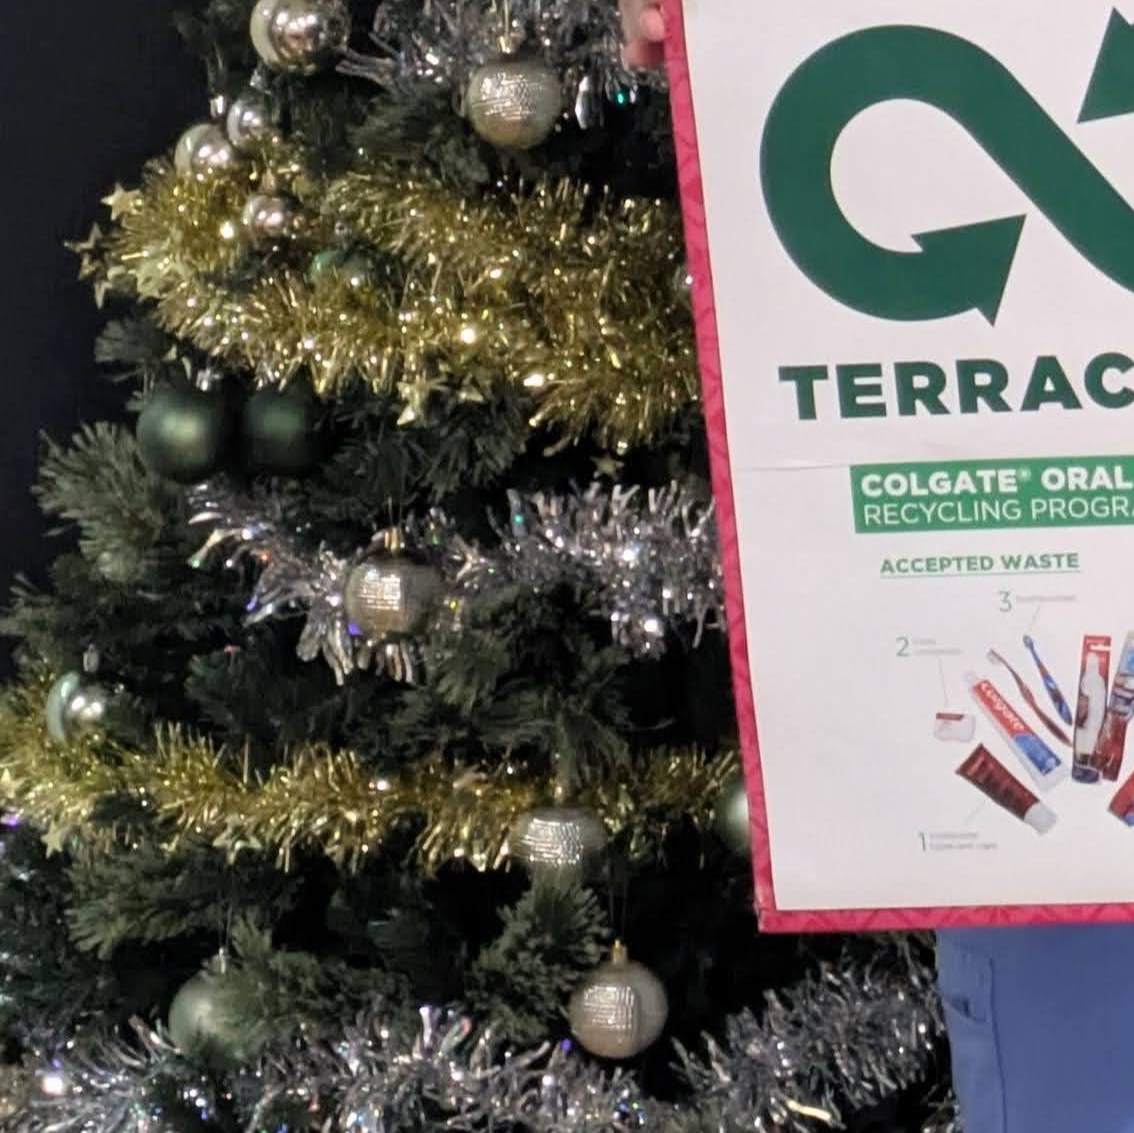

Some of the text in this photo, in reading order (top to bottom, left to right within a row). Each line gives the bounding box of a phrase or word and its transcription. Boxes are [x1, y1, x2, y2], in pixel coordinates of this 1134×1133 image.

[1040, 465, 1134, 491] ORAL
[863, 499, 1022, 526] RECYCLING
[880, 552, 1080, 574] ACCEPTED WASTE
[998, 590, 1012, 613] 3
[896, 636, 910, 657] 2
